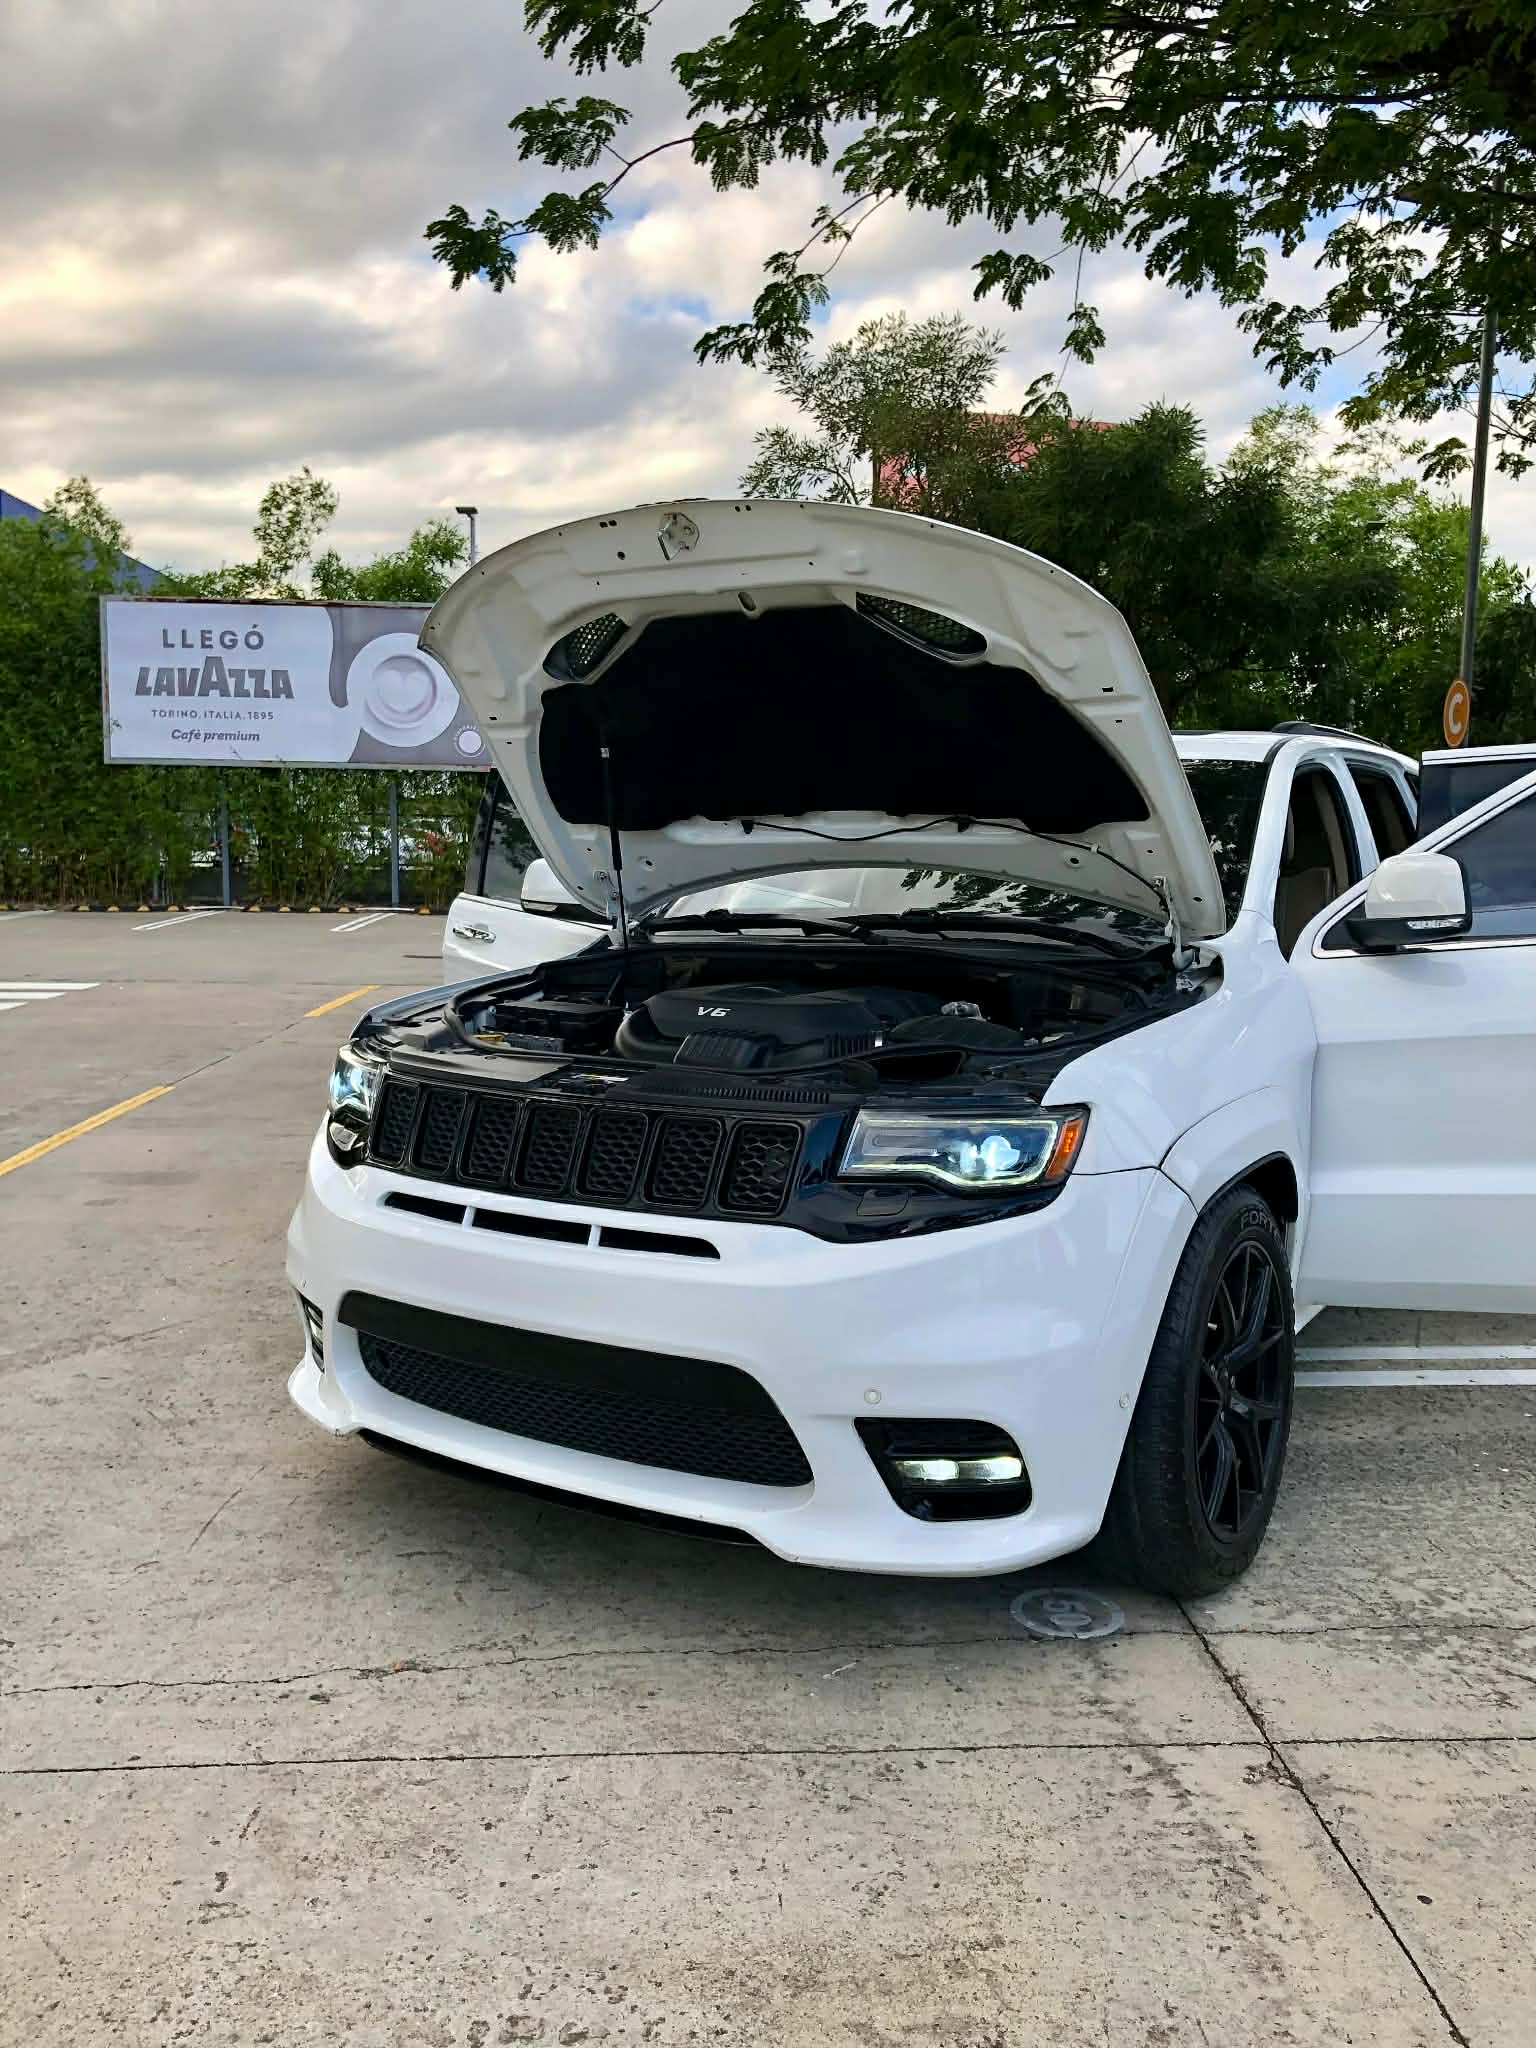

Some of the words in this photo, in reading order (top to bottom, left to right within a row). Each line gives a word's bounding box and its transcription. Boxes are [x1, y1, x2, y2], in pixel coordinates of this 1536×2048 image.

[162, 624, 264, 650] LLEGÓ
[135, 656, 294, 699] LAVAZZA
[1448, 693, 1463, 735] C
[171, 728, 201, 742] Café
[203, 730, 260, 742] premium
[697, 1006, 731, 1017] V6
